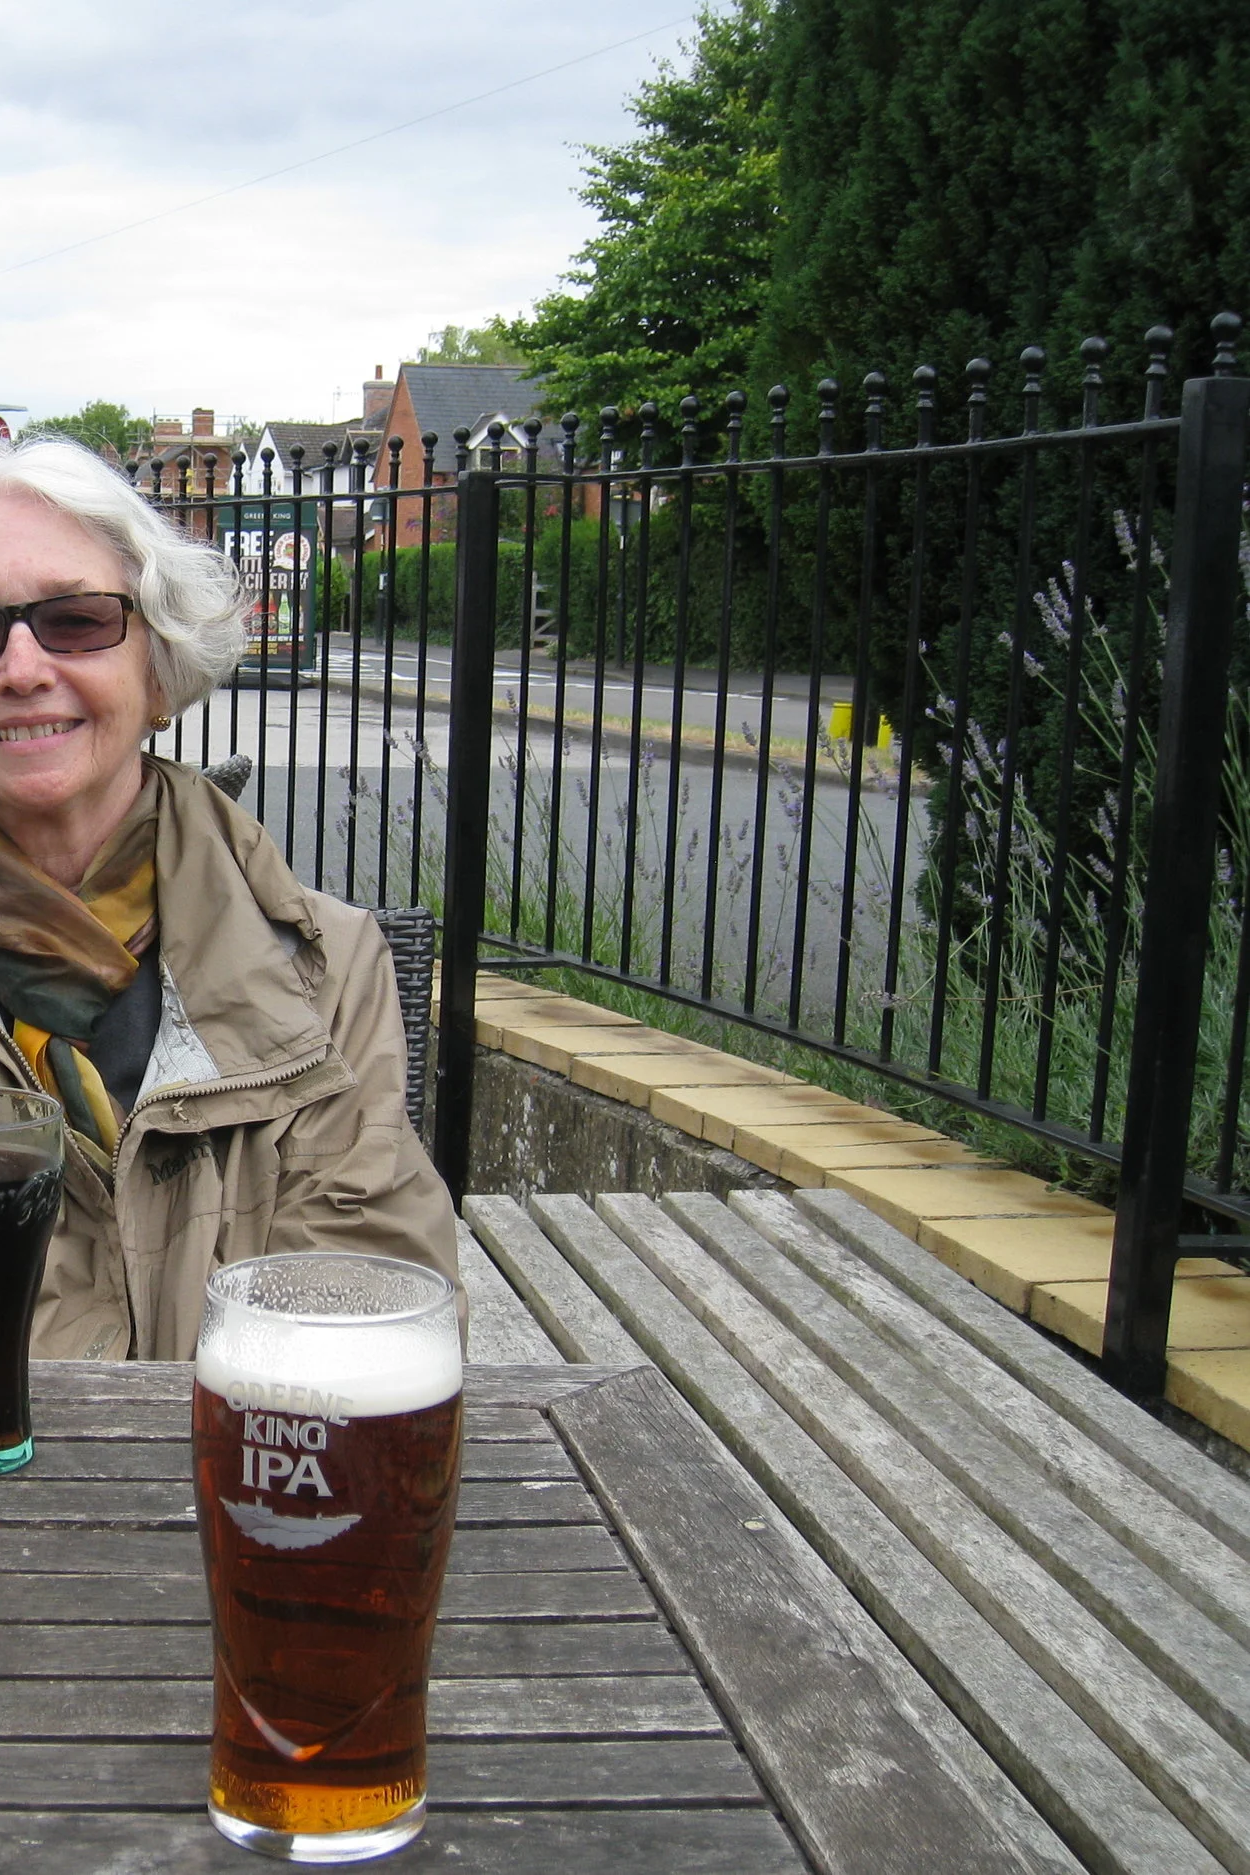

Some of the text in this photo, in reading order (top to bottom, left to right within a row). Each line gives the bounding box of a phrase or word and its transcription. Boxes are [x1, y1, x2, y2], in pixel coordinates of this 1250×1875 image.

[272, 512, 292, 520] KING
[225, 1379, 354, 1428] GREENE
[243, 1411, 327, 1451] KING
[241, 1445, 334, 1498] IPA
